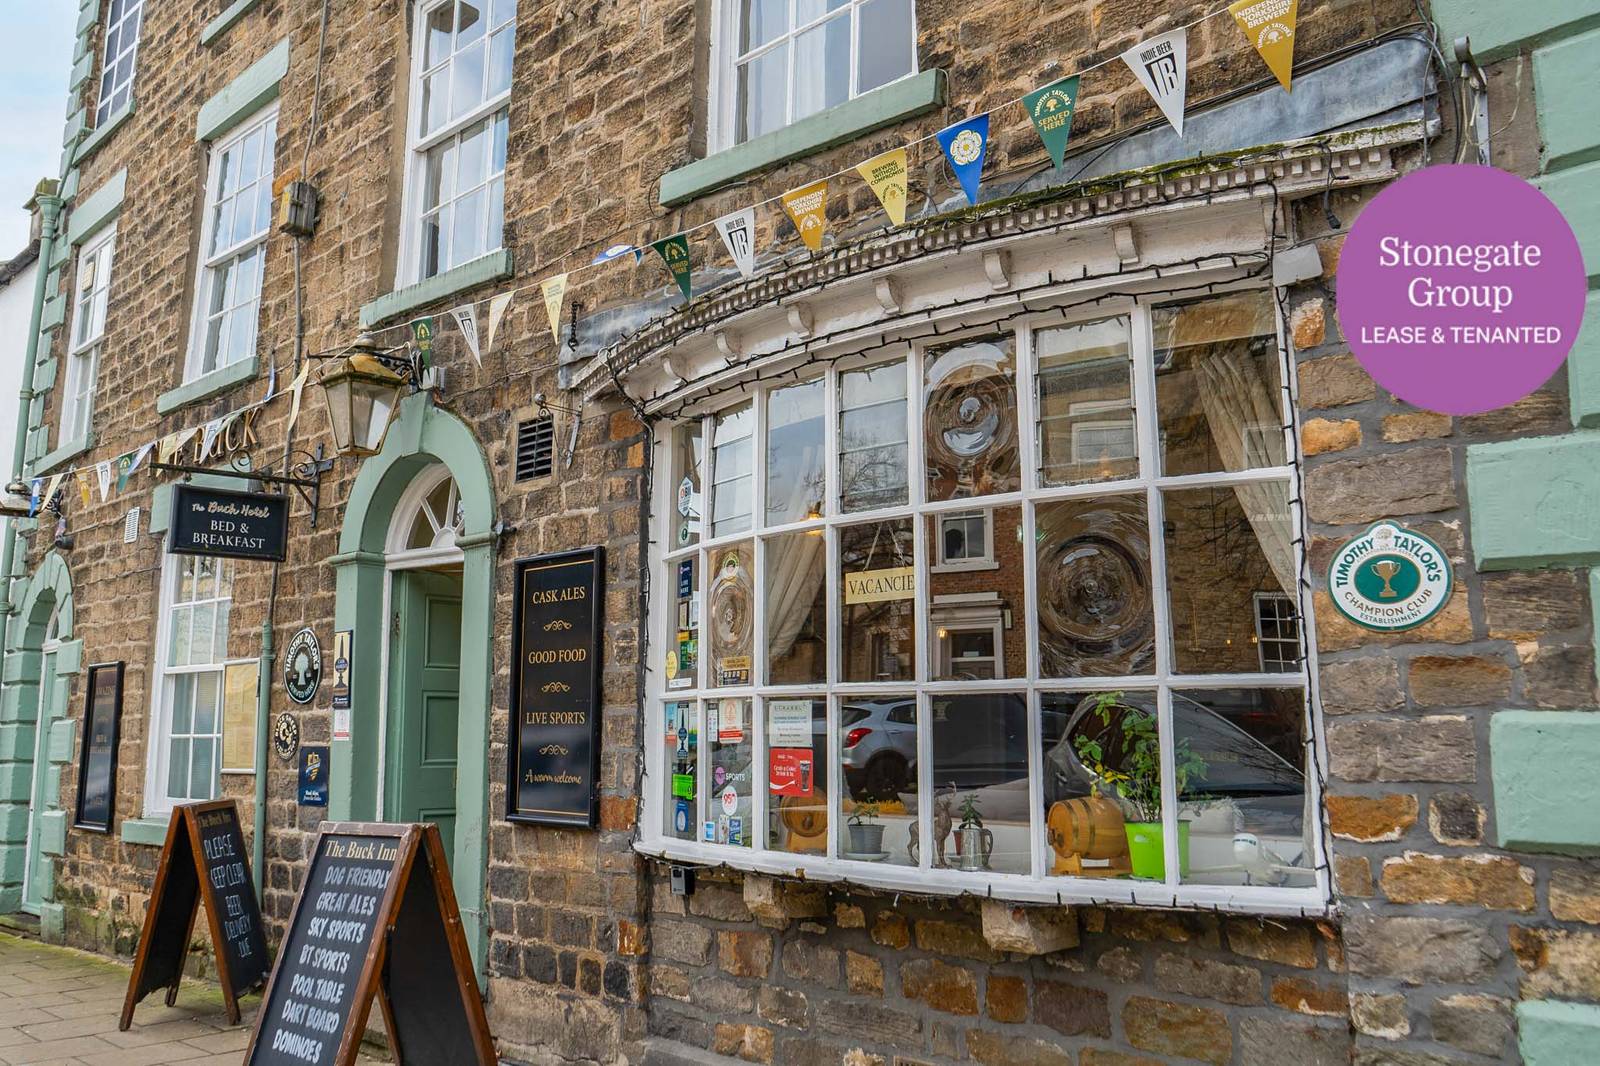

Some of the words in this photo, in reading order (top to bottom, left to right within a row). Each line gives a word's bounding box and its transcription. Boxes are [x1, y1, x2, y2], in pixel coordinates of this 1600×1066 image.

[1235, 0, 1281, 20] INDEPEN
[1247, 6, 1290, 29] BREWERY
[1140, 47, 1157, 63] INDIE
[1156, 40, 1173, 56] BEER
[1034, 92, 1050, 117] TIMOTHY
[1038, 110, 1070, 127] SERVED
[1043, 119, 1066, 132] HERE
[870, 166, 905, 185] COMPROMISE
[871, 160, 898, 174] BREWING
[872, 164, 899, 179] WITHOUT
[207, 501, 240, 516] Buck
[240, 504, 270, 519] Hotel
[210, 519, 235, 532] BED
[240, 522, 250, 534] &
[193, 532, 266, 549] BREAKFAST
[1336, 538, 1374, 588] TIMOTHY
[1393, 535, 1441, 583] TAYLOR'S
[532, 589, 559, 604] CASK
[560, 586, 586, 601] ALES
[848, 574, 915, 595] VACANCIE
[1344, 591, 1404, 617] CHAMPION
[1406, 588, 1432, 612] CLUB
[1360, 610, 1422, 625] ESTABLISHMENT
[285, 633, 304, 673] TIMOTHY
[304, 632, 320, 671] TAYLOR'S
[528, 650, 557, 664] GOOD
[559, 648, 586, 663] FOOD
[526, 712, 548, 725] LIVE
[549, 711, 585, 725] SPORTS
[725, 773, 745, 782] SPORTS
[204, 834, 236, 860] PLEASE
[325, 840, 346, 858] The
[346, 841, 374, 859] Buck
[376, 843, 398, 861] Inn
[324, 865, 346, 885] DOG
[347, 867, 393, 890] FRIENDLY
[315, 891, 348, 912] GREAT
[349, 894, 377, 916] ALES
[307, 917, 328, 938] SKY
[327, 919, 367, 944] SPORTS
[299, 944, 315, 965] BT
[312, 947, 350, 974] SPORTS
[290, 973, 315, 997] POOL
[313, 979, 345, 1004] TABLE
[281, 1000, 307, 1025] DART
[305, 1003, 340, 1034] BOARD
[271, 1029, 323, 1065] DOMINOES
